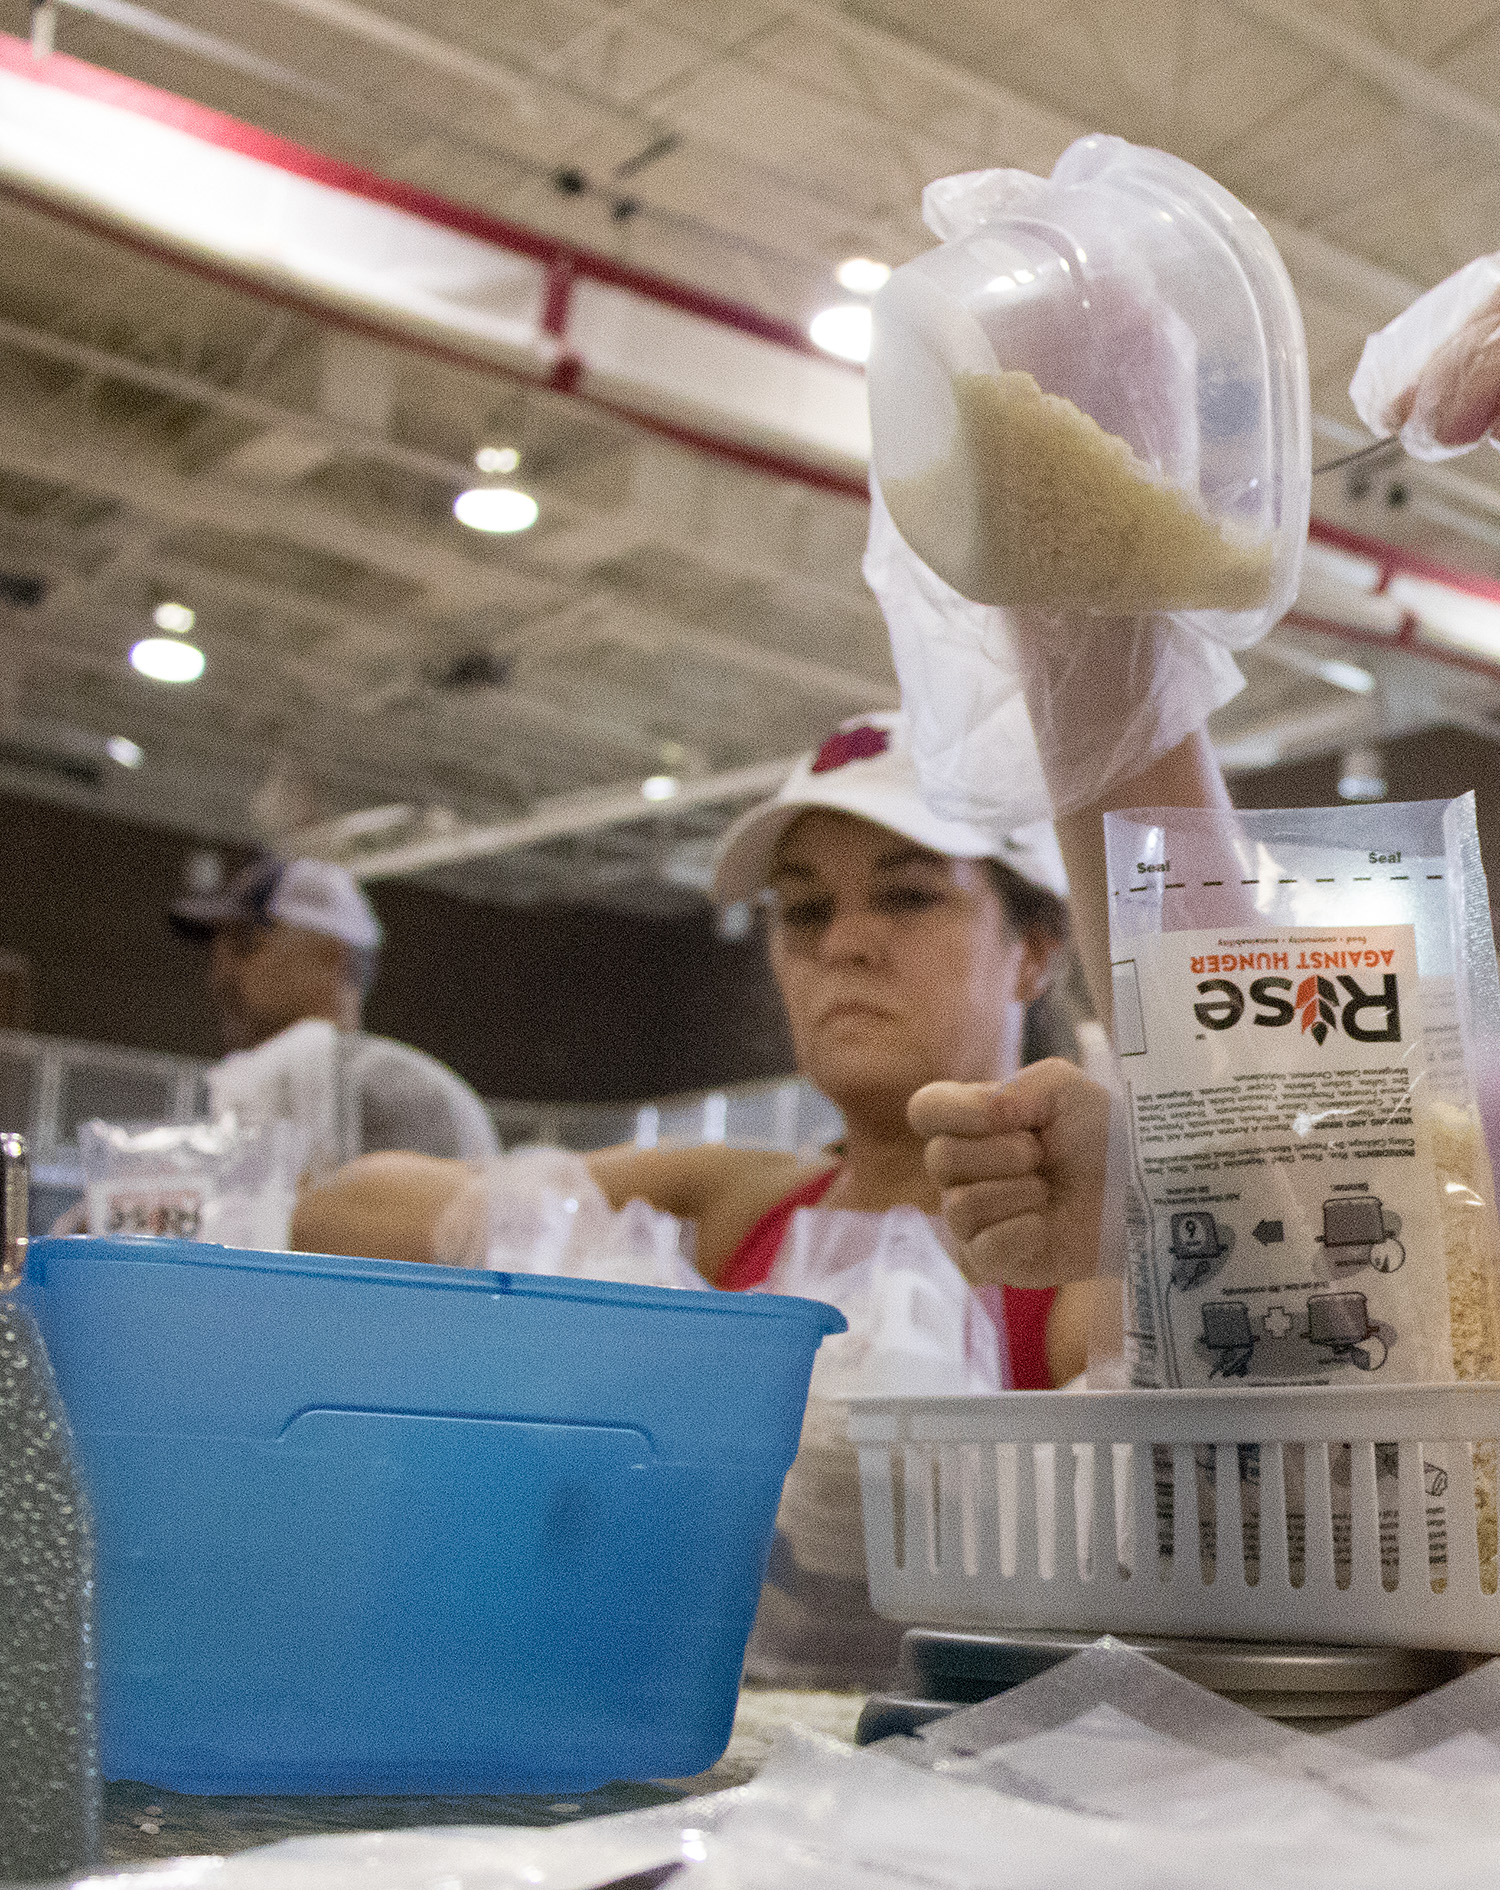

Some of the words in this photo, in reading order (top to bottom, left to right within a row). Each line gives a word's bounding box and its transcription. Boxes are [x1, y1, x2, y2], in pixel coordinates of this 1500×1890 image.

[1368, 852, 1402, 865] Seal
[1137, 860, 1171, 874] Seal
[1218, 937, 1279, 948] sustainability
[1288, 937, 1337, 947] community
[1346, 936, 1367, 946] food
[1190, 953, 1289, 974] HUNGER
[1296, 949, 1395, 970] AGAINST
